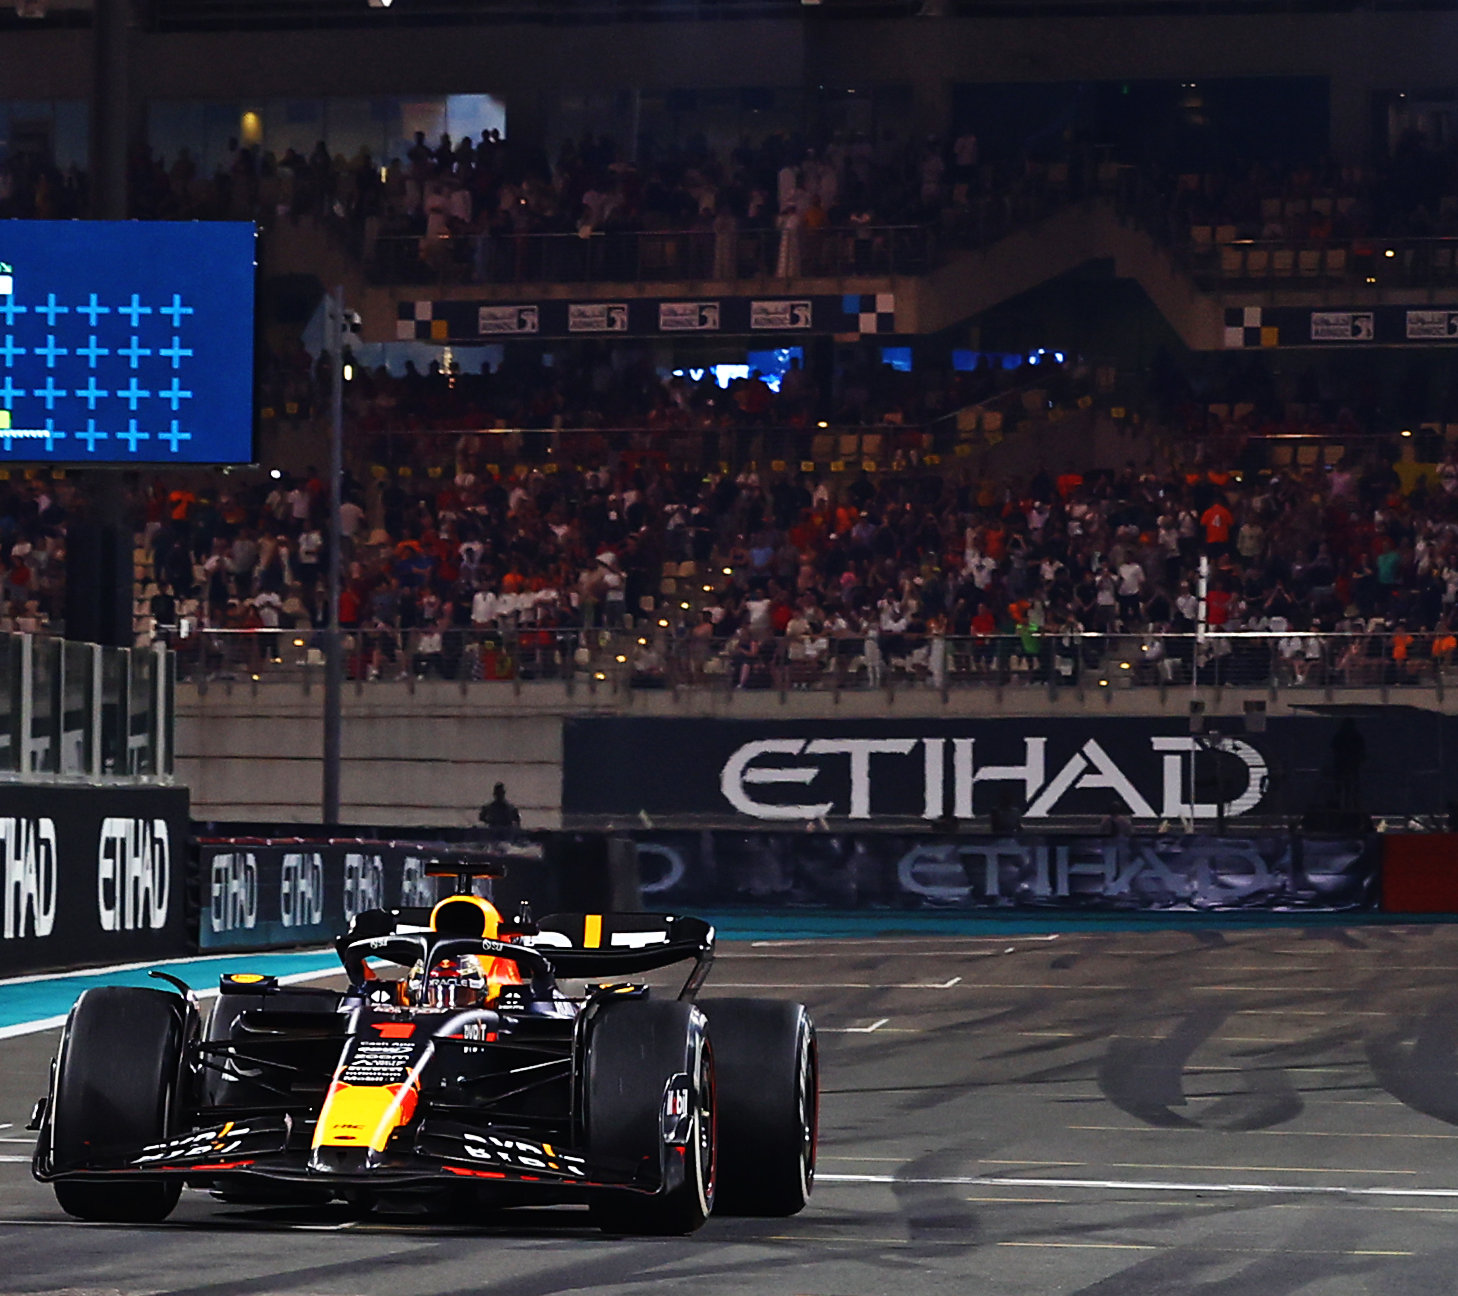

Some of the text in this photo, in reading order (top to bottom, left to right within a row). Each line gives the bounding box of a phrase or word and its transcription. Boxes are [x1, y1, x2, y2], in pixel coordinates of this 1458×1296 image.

[721, 736, 1268, 820] ETIHAD
[98, 817, 170, 931] ETIHAD
[212, 853, 258, 932] ETIHAD
[282, 853, 323, 927] ETIHAD
[898, 840, 1267, 899] ETIHAD
[370, 1022, 417, 1039] 1
[667, 1089, 688, 1115] Mobil
